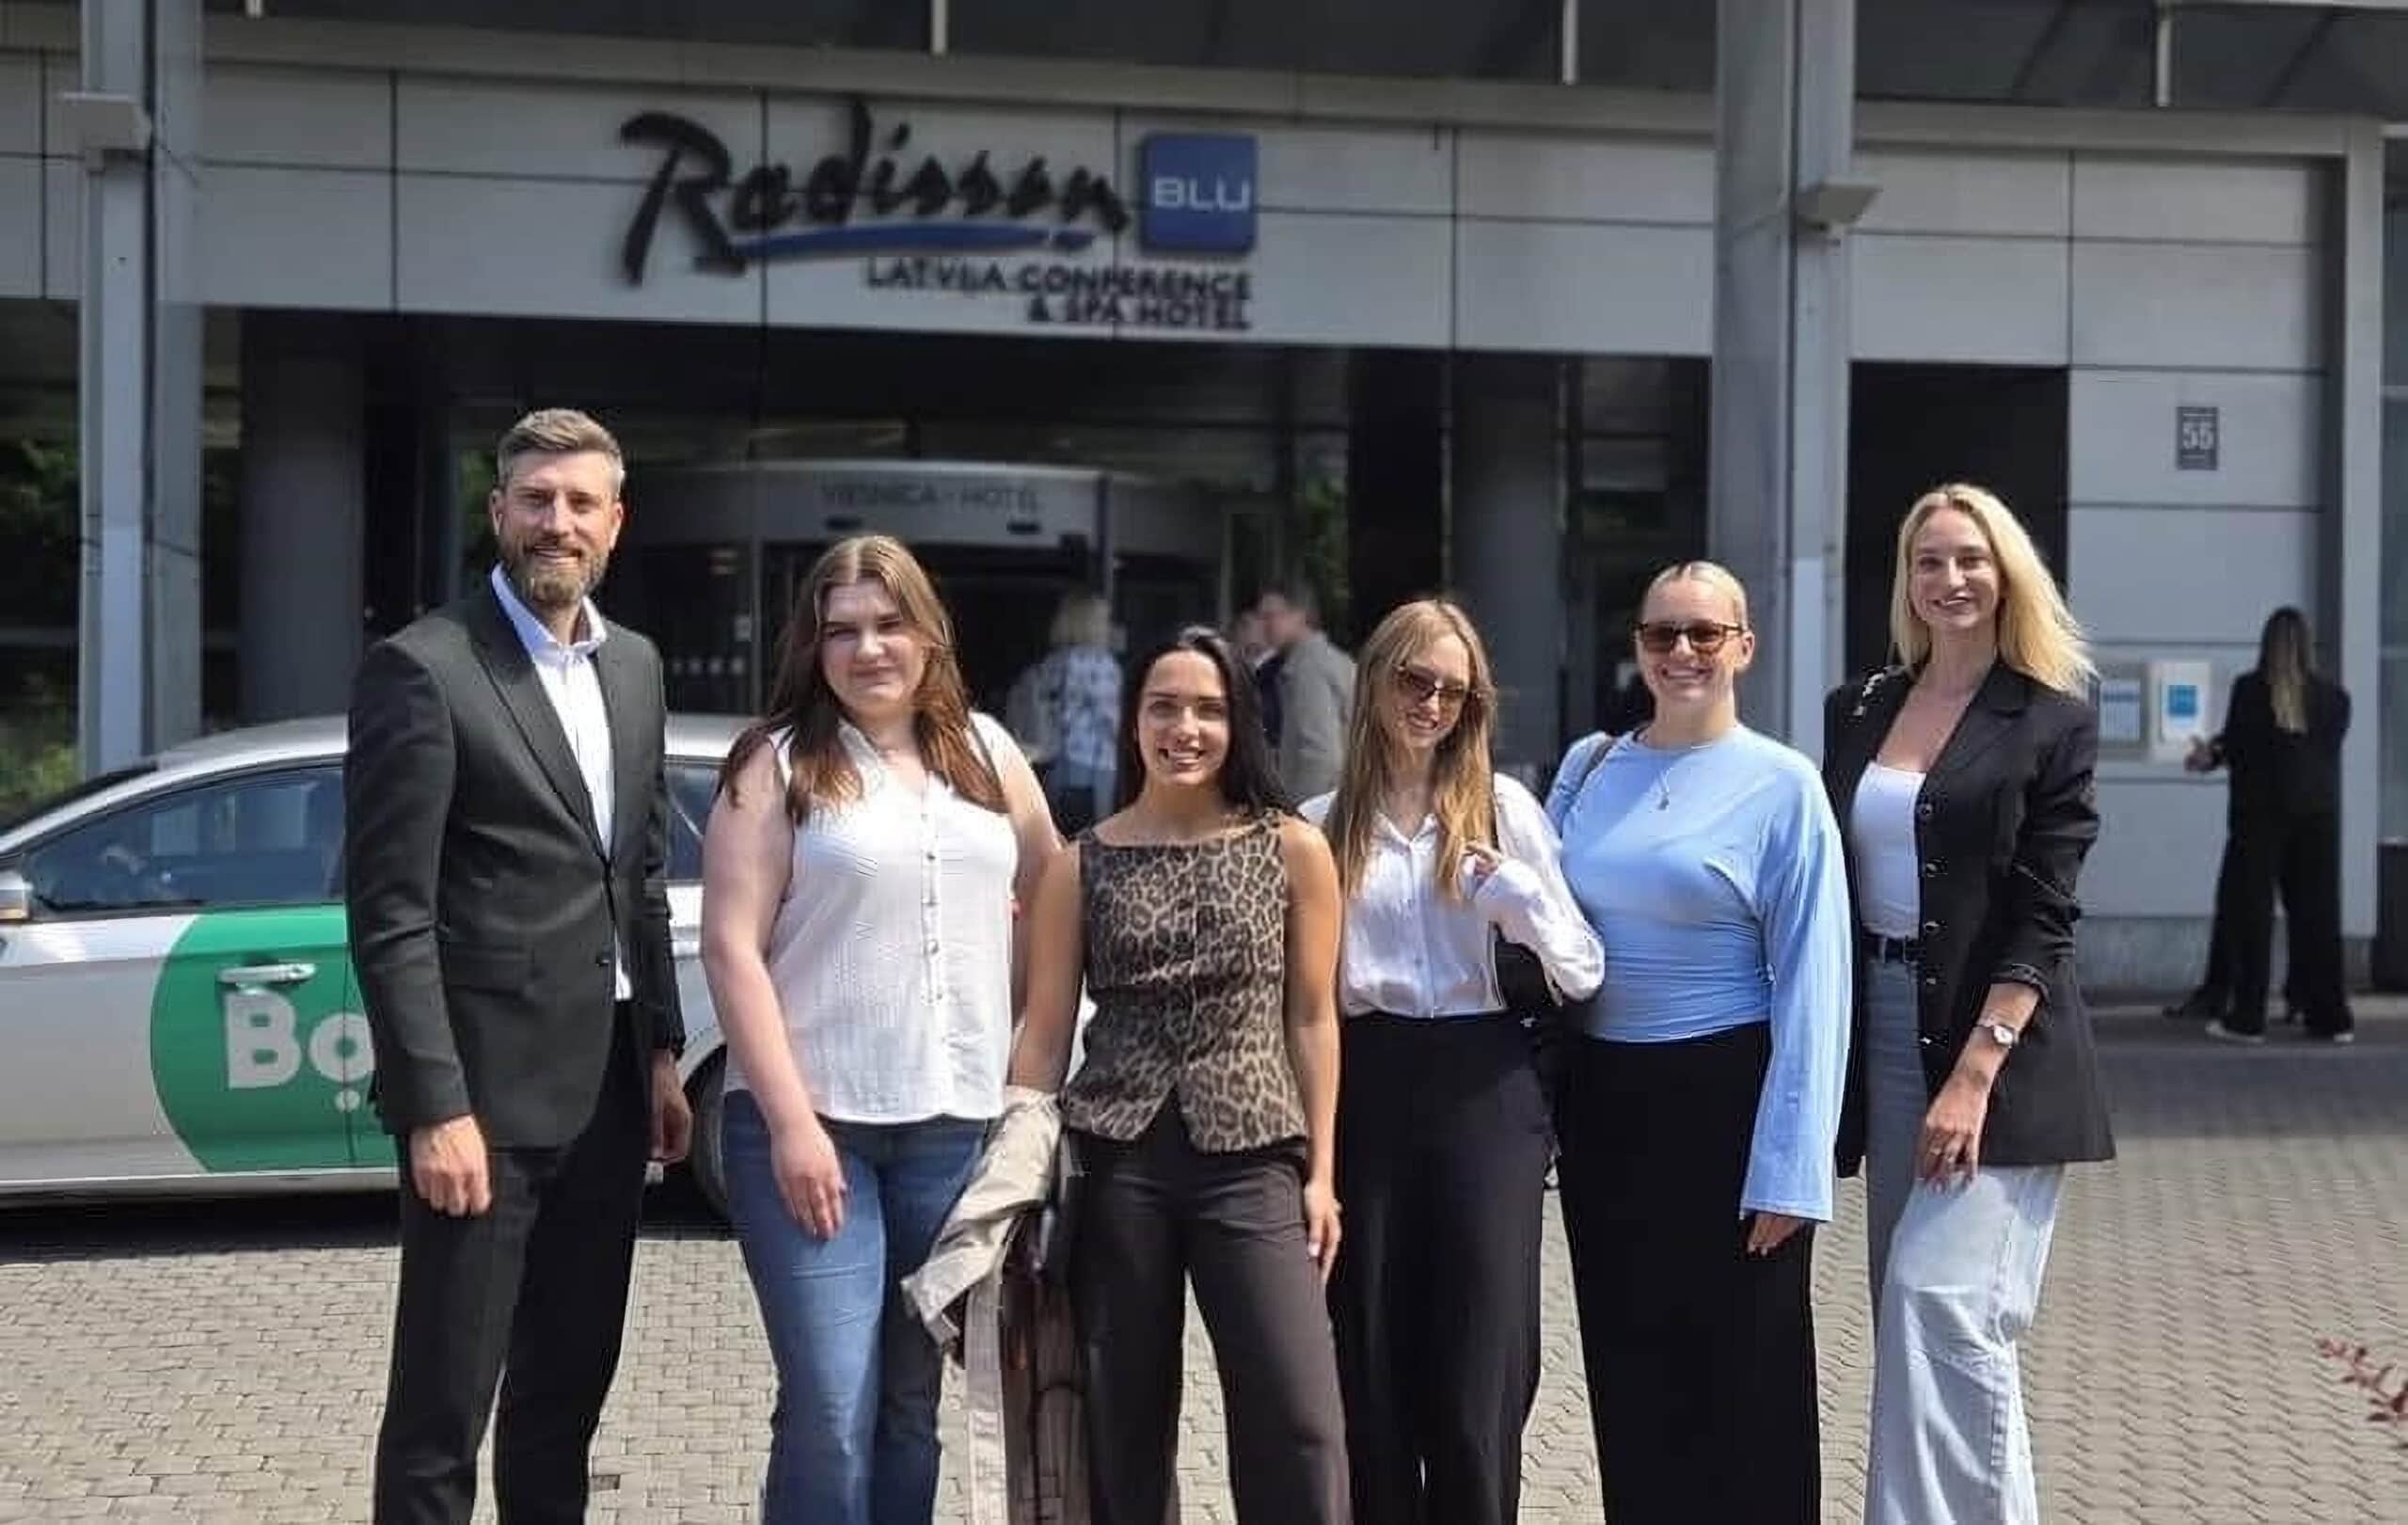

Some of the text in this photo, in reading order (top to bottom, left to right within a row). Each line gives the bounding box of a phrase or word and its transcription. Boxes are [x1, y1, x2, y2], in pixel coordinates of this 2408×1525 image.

[619, 100, 1251, 286] Radisson BLU
[866, 257, 1252, 301] LATVIA CONFERENCE
[1066, 297, 1125, 325] SPA
[1137, 299, 1252, 330] HOTEL
[2181, 421, 2214, 451] 55
[225, 988, 375, 1114] Bo
